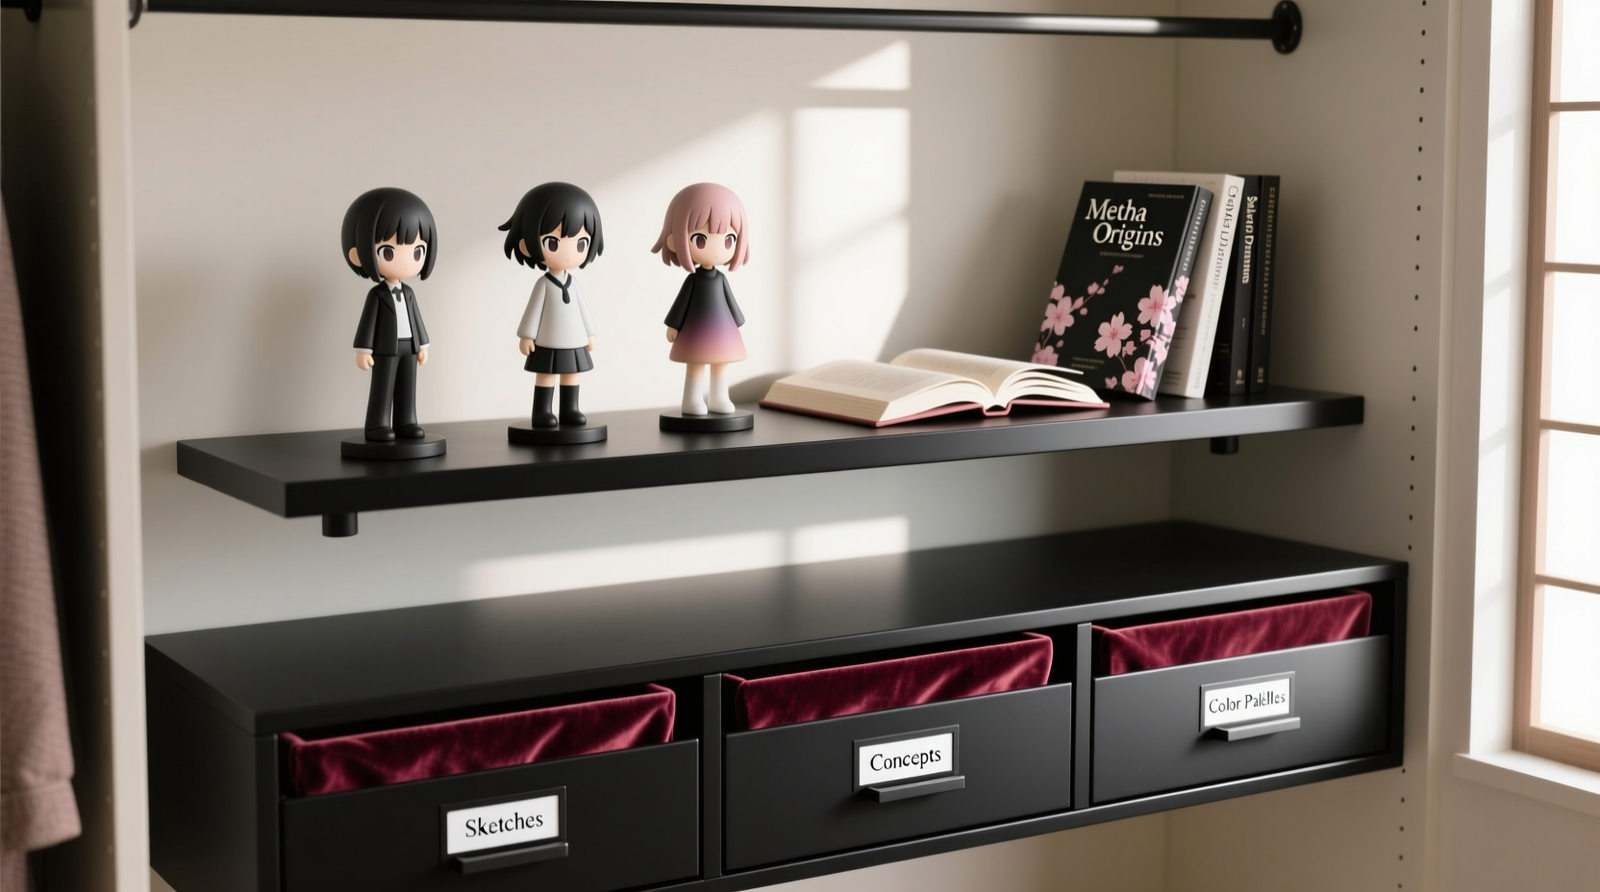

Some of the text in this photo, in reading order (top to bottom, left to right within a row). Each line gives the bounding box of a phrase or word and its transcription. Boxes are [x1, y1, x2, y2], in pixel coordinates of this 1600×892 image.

[1085, 198, 1147, 222] Metha
[1093, 222, 1164, 251] Origins
[1209, 697, 1241, 713] Color
[870, 749, 941, 771] Concepts
[465, 812, 543, 837] Sketches
